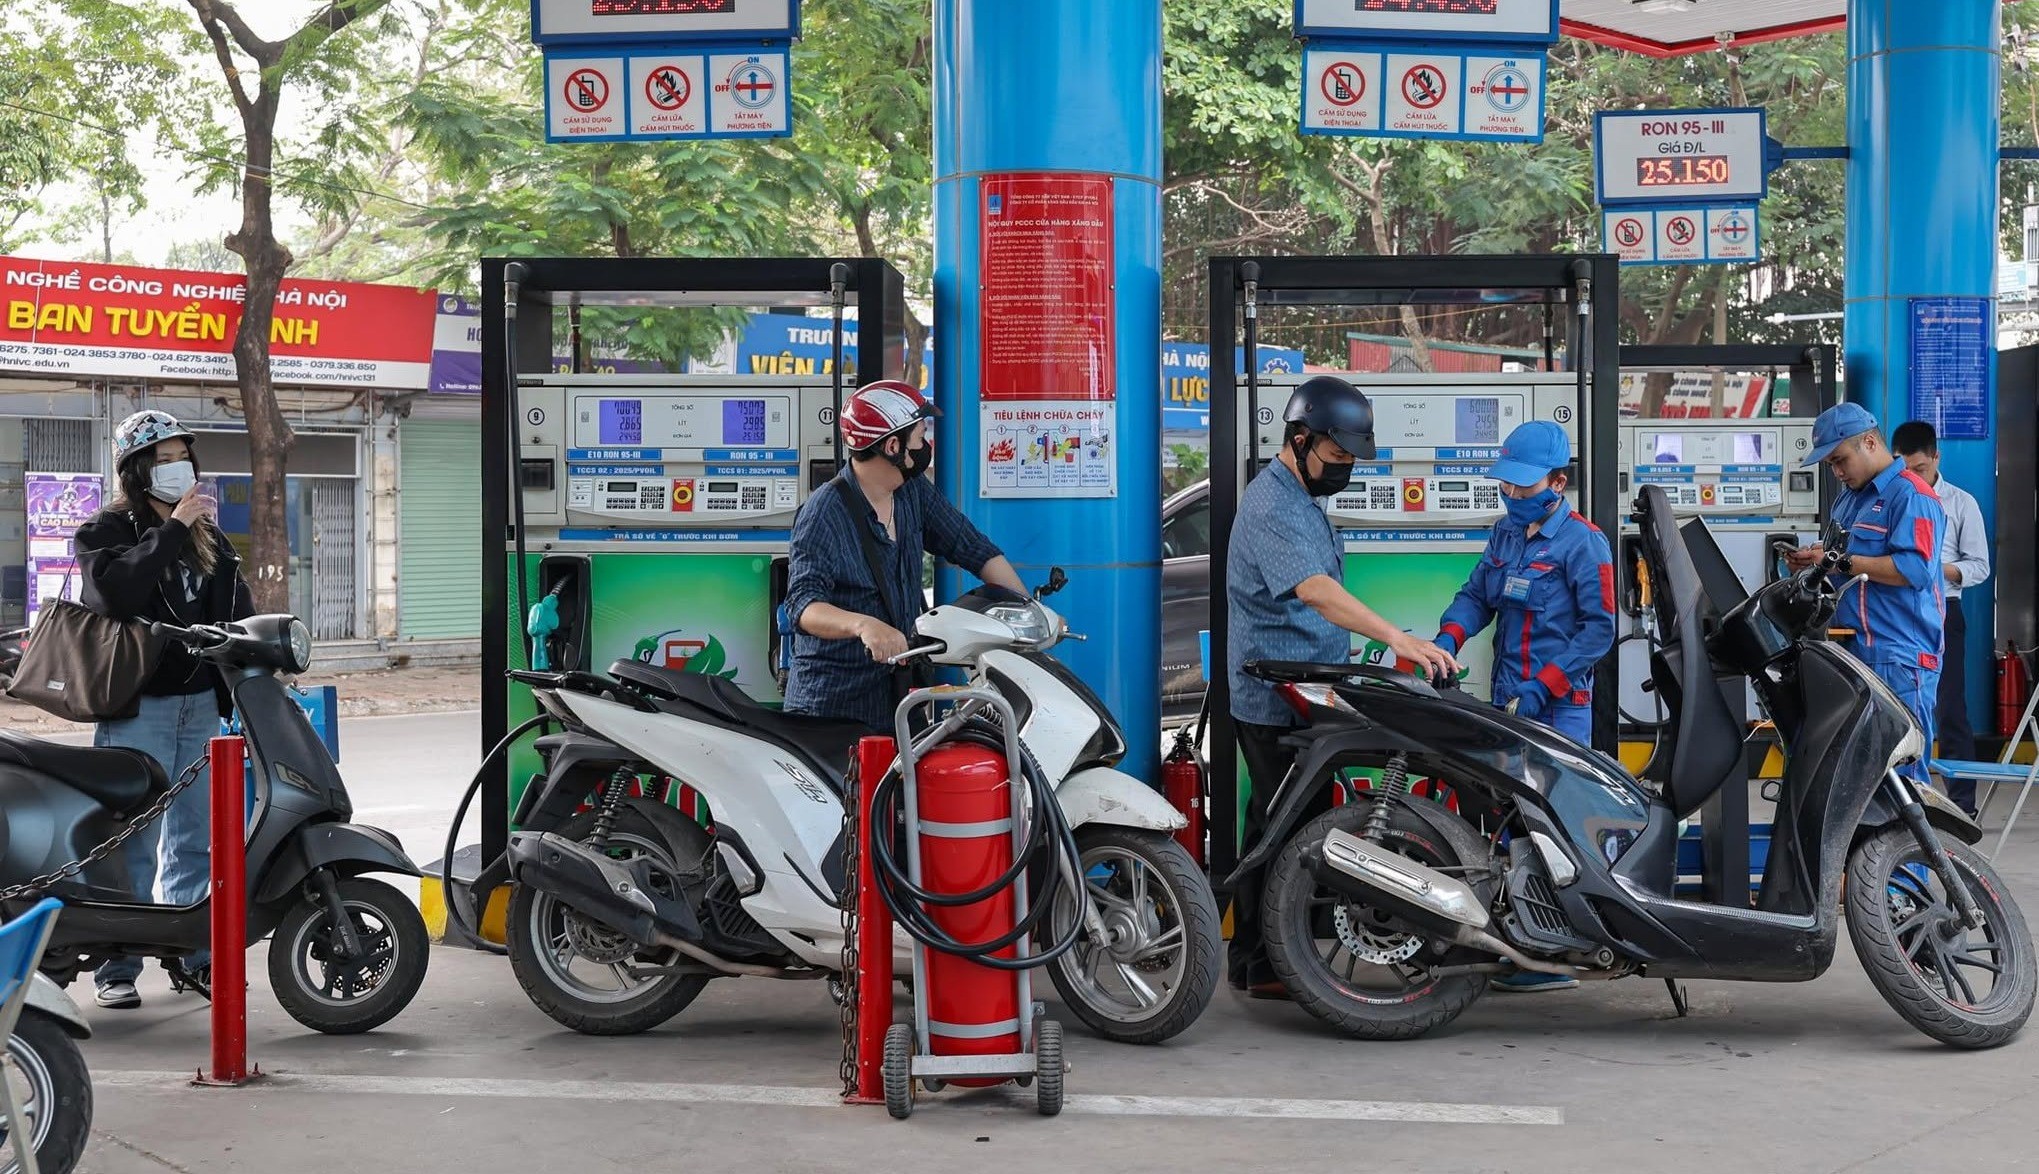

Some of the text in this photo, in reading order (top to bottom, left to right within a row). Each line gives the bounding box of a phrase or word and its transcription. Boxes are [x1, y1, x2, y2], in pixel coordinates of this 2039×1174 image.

[1641, 121, 1677, 136] RON
[1658, 141, 1705, 154] Giá Đ/L
[1641, 158, 1727, 184] 25.150
[6, 268, 81, 290] NGHỀ
[89, 275, 163, 296] CÔNG
[172, 284, 247, 304] NGHIỆ
[307, 289, 348, 311] NỘI
[9, 300, 93, 334] BAN
[105, 300, 227, 341] TUYỂN
[993, 410, 1013, 420] TIÊU
[1016, 410, 1040, 423] LỆNH
[1044, 409, 1073, 420] CHỮA
[730, 451, 747, 459] RON
[1456, 450, 1470, 458] E10
[1472, 450, 1488, 458] RON
[1343, 532, 1355, 540] RẢ
[1190, 797, 1199, 809] 16
